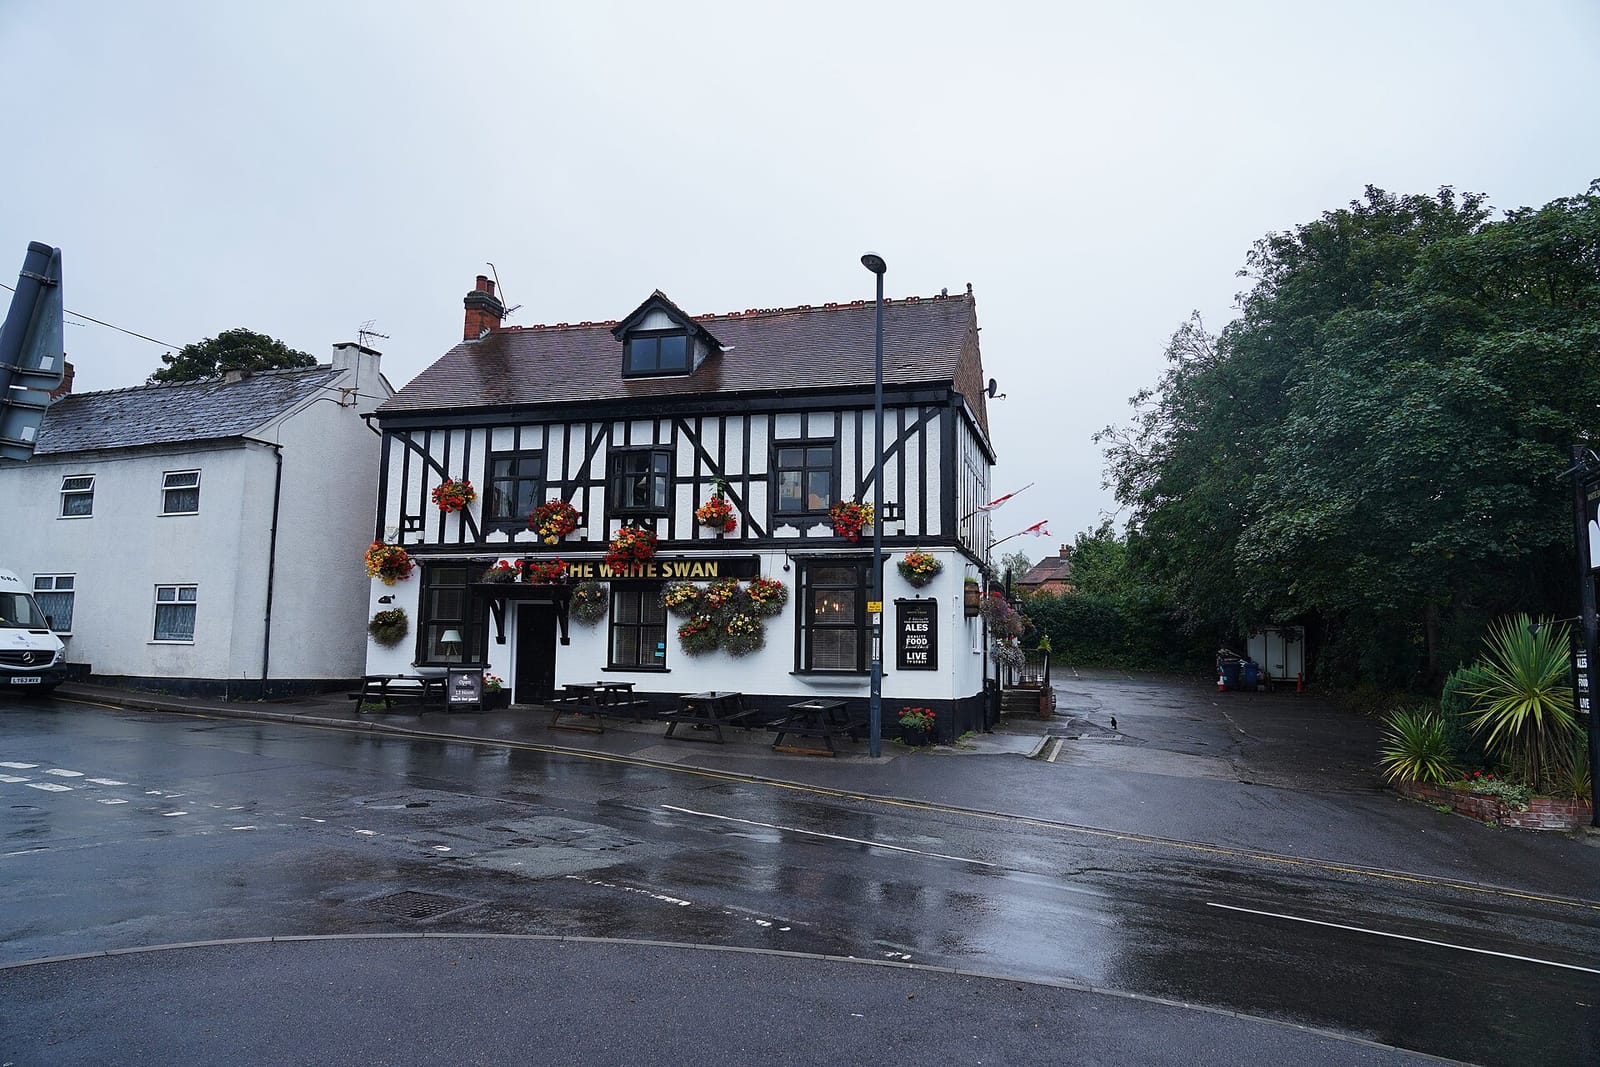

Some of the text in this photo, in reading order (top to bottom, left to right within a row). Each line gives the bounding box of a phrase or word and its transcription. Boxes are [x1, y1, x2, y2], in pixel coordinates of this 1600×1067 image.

[662, 561, 718, 577] SWAN
[905, 623, 929, 632] ALES
[906, 652, 928, 660] LIVE
